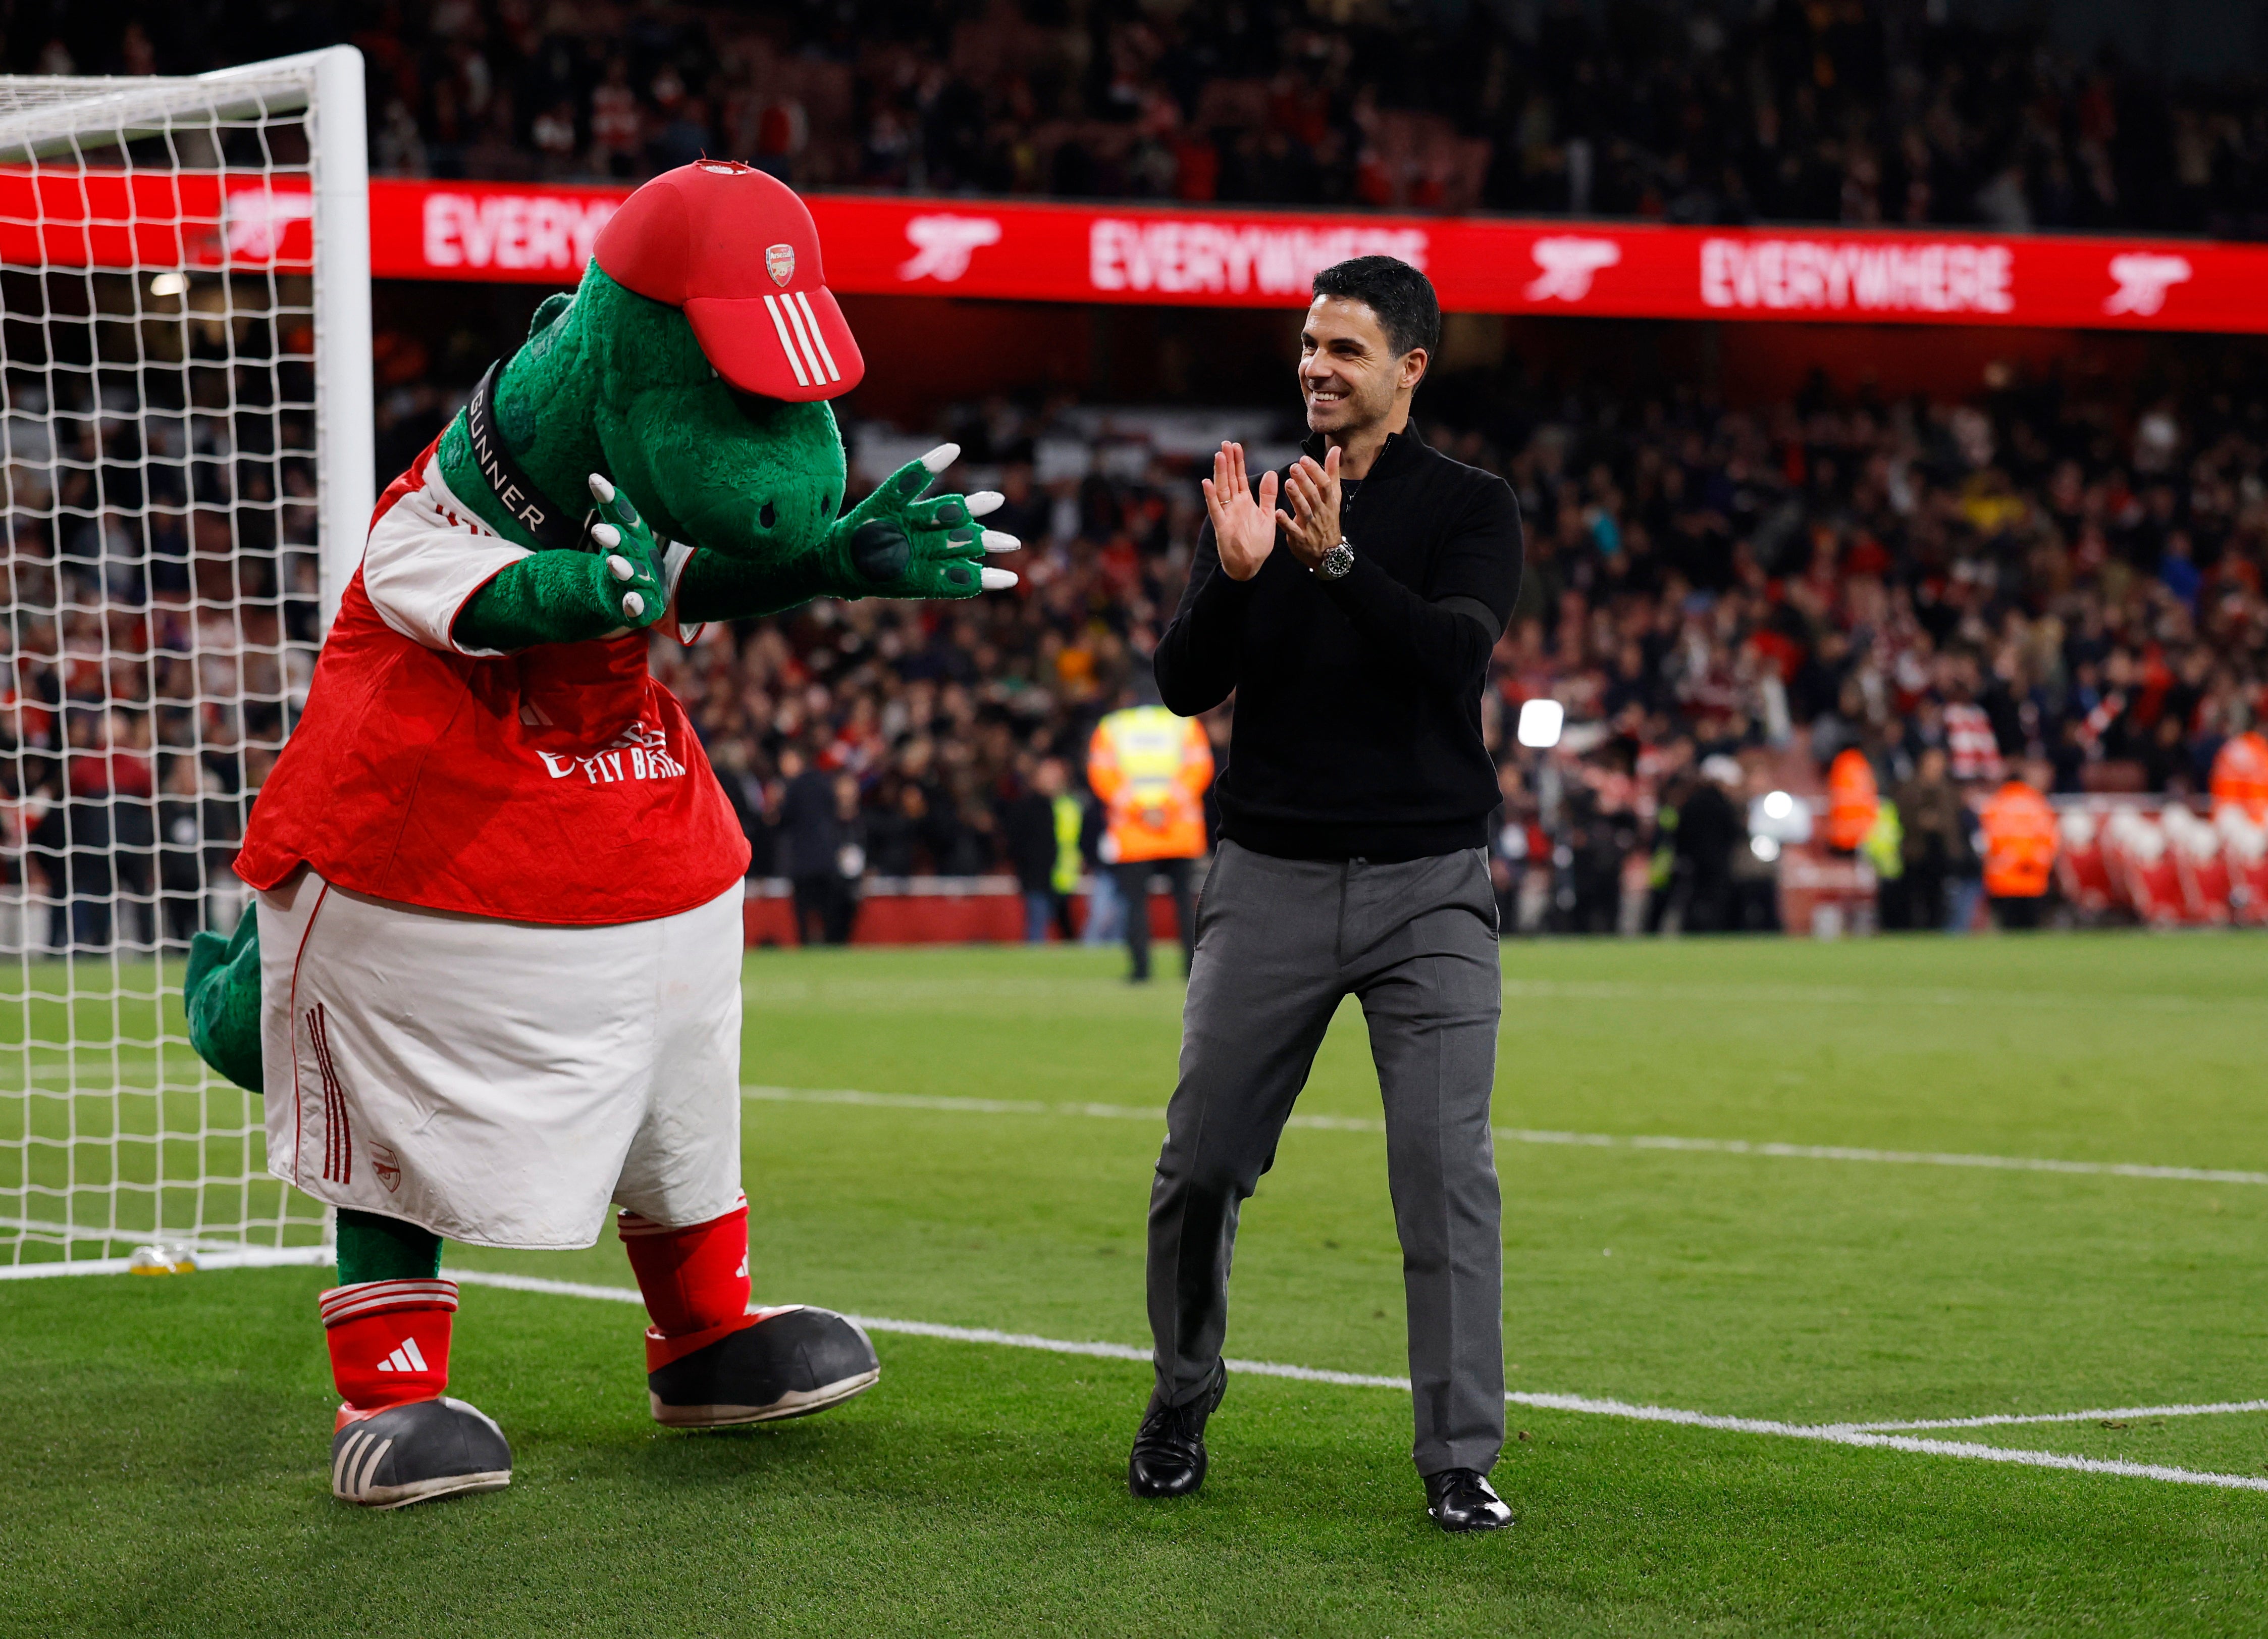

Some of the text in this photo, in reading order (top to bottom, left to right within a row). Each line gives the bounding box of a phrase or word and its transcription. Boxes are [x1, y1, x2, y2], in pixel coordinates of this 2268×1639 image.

[424, 193, 620, 271] EVERY
[770, 251, 791, 259] Arsenal
[1701, 238, 2013, 313] EVERYWHERE
[470, 389, 545, 532] GUNNER
[584, 752, 624, 784] FLY
